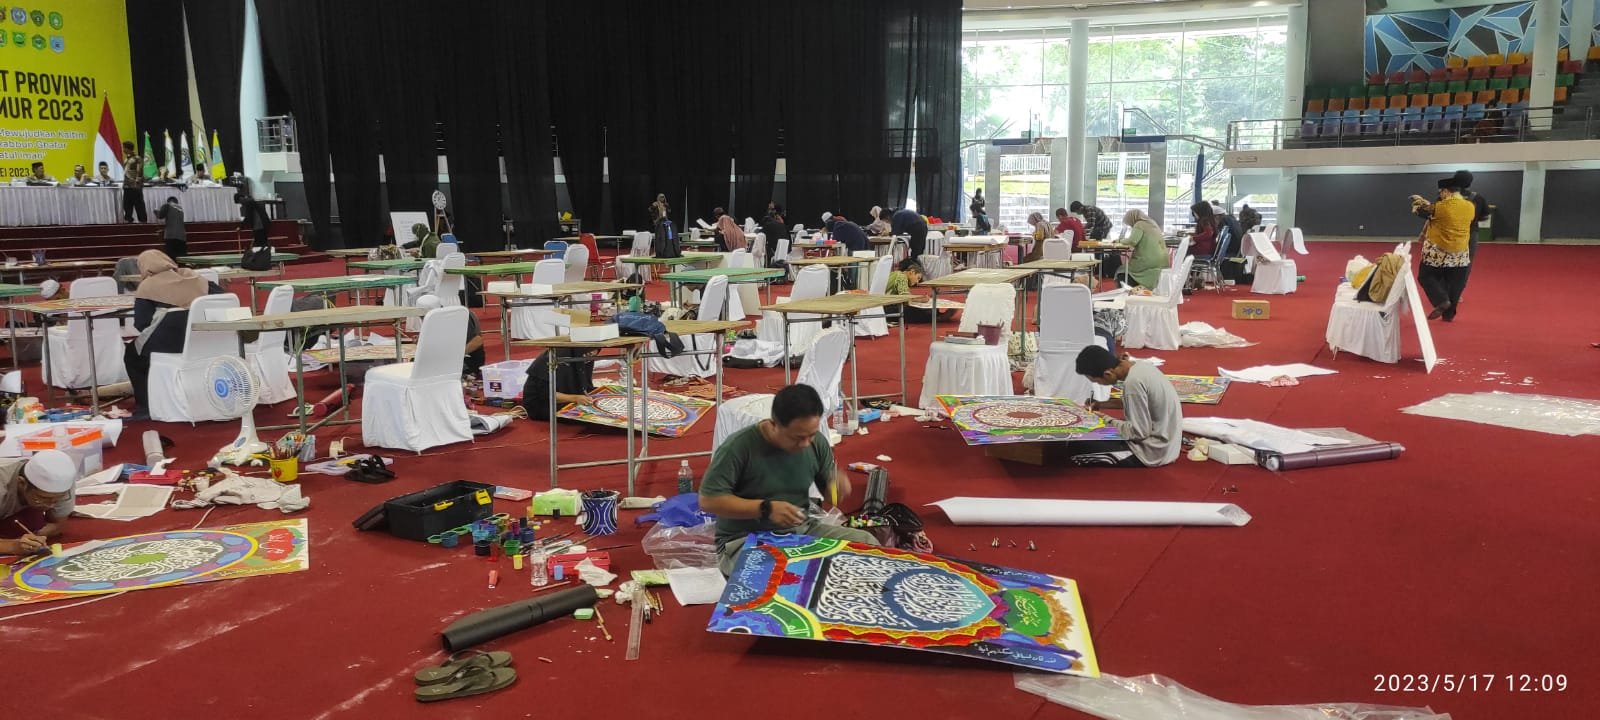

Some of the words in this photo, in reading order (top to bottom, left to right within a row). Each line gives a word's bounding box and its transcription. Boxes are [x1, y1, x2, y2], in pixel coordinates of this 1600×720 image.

[15, 71, 96, 98] PROVINSI
[38, 98, 84, 121] 2023
[9, 168, 30, 178] 2023
